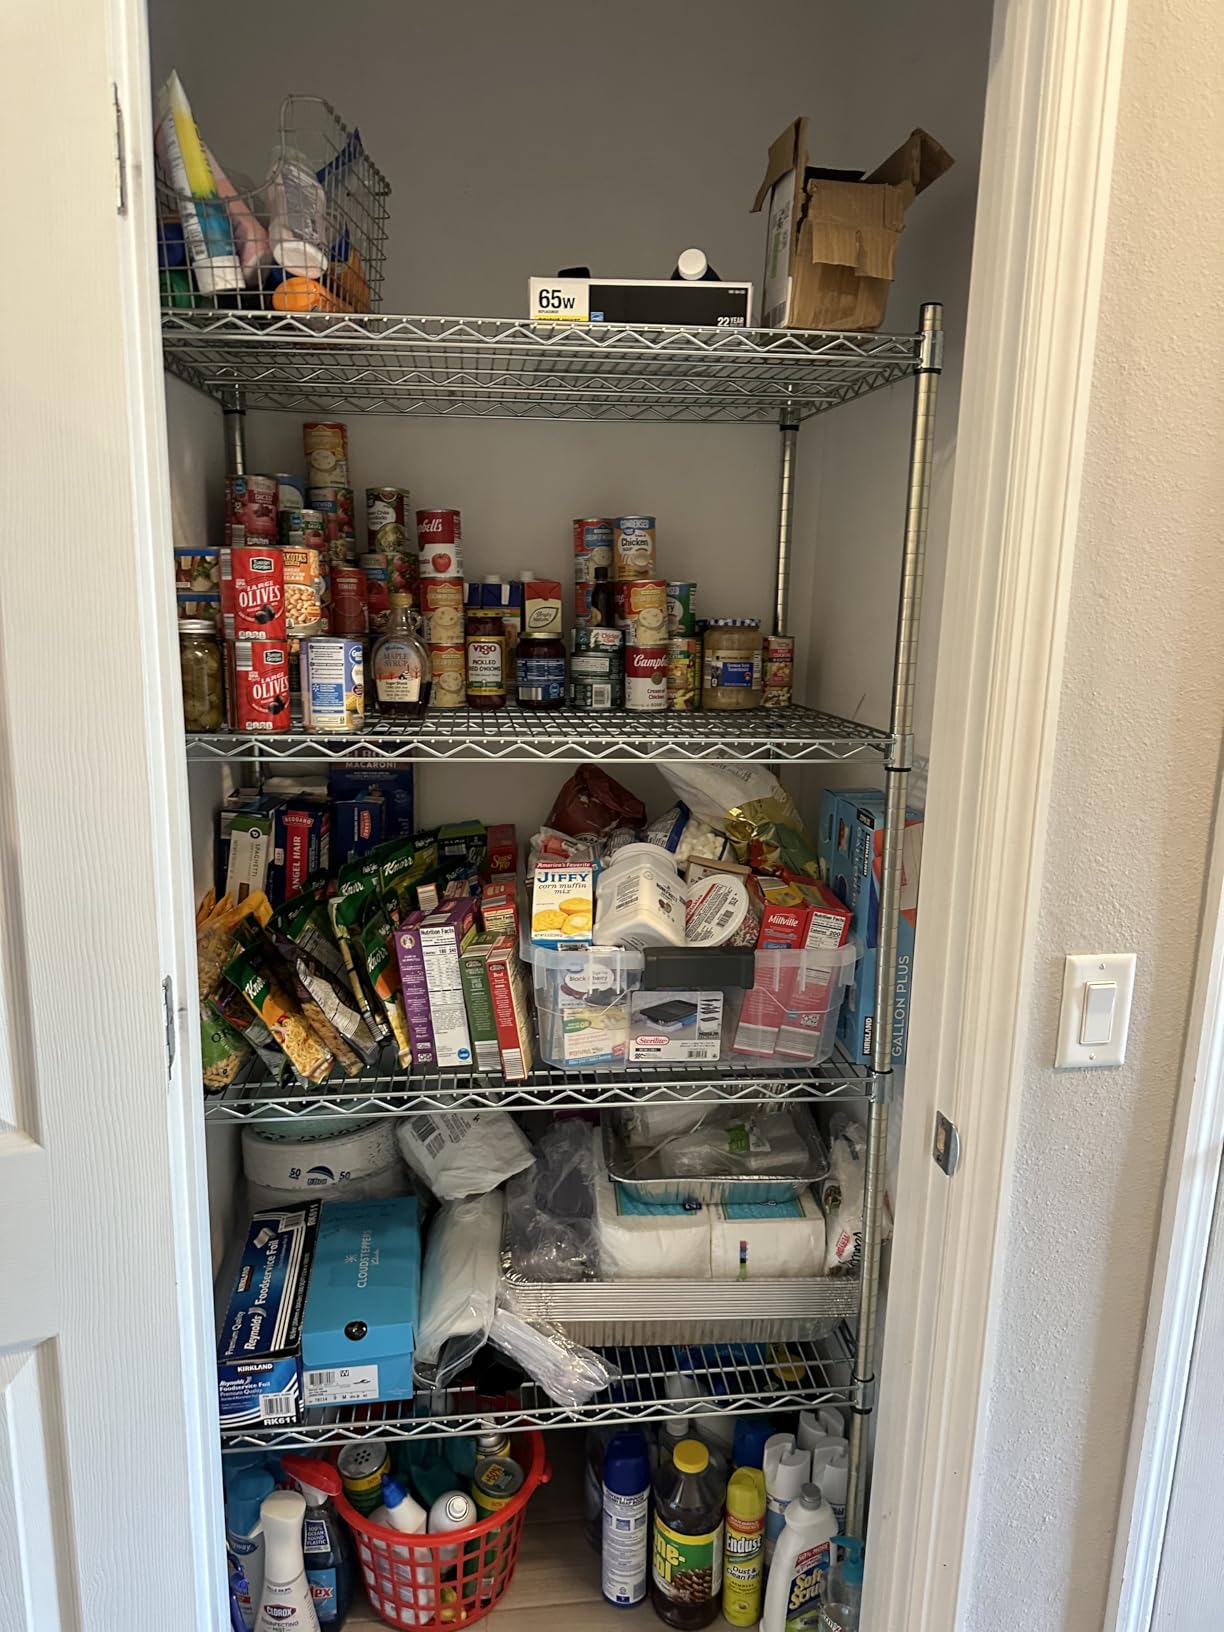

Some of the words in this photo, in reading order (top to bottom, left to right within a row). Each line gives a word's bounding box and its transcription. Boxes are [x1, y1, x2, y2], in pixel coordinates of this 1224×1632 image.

[717, 317, 730, 327] 22
[621, 537, 648, 547] Chicken
[247, 581, 273, 591] LARGE
[239, 585, 280, 607] OLIVES
[261, 672, 284, 683] LARGE
[253, 676, 288, 699] OLIVES
[293, 836, 302, 859] HAIR
[251, 843, 261, 878] SPAGHETTI
[383, 857, 413, 876] Knorr
[292, 861, 301, 889] ANGEL
[537, 871, 589, 883] JIFFY
[341, 881, 364, 896] Knorr
[559, 882, 587, 890] muffin
[768, 914, 799, 927] Millville
[441, 926, 454, 934] Facts
[896, 955, 910, 993] PLUS
[892, 998, 906, 1057] GALLON
[863, 1017, 873, 1055] KIRKLAND
[289, 1167, 302, 1177] 50
[339, 1170, 351, 1180] 50
[237, 1265, 251, 1293] KIRKLAND
[243, 1314, 263, 1350] Reynolds
[254, 1253, 276, 1306] Foodservice
[265, 1238, 280, 1256] Foil
[231, 1311, 246, 1331] Quality
[225, 1329, 240, 1356] Premium
[237, 1363, 273, 1373] KIRKLAND
[219, 1383, 257, 1392] Foodservice
[263, 1416, 297, 1426] RK611
[726, 1533, 762, 1553] Endust
[732, 1566, 748, 1575] Dust
[795, 1568, 824, 1587] Soft
[266, 1606, 293, 1616] CLOROX
